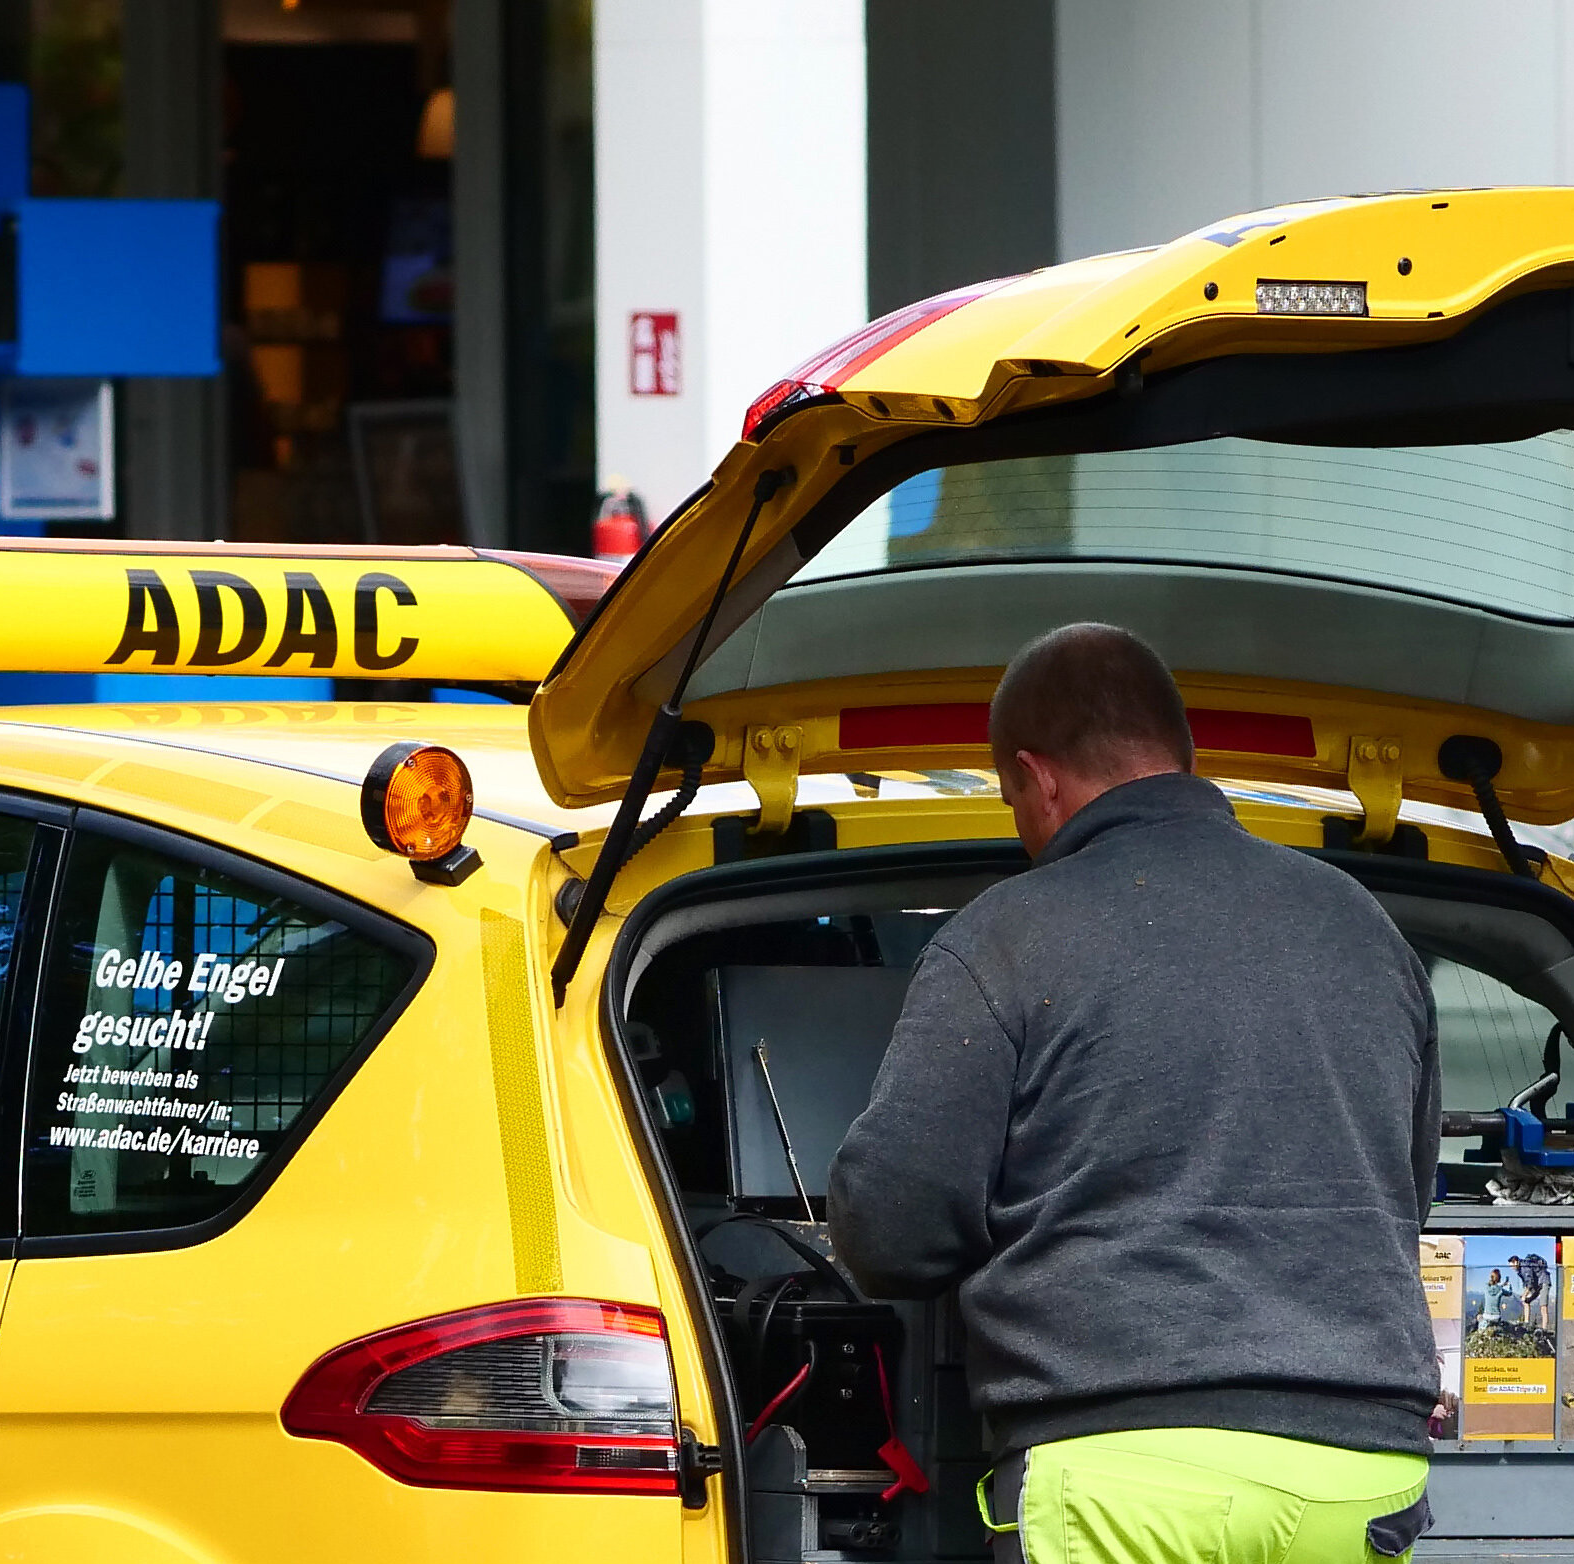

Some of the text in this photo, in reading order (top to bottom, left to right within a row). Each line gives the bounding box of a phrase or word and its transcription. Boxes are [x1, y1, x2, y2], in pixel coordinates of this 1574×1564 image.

[104, 568, 420, 670] ADAC
[96, 949, 285, 1003] Gelbe Engel
[72, 1009, 214, 1053] gesucht!
[63, 1064, 199, 1090] Jetzt bewerben als
[56, 1092, 233, 1122] Straßenwachtfahrer/in:
[49, 1125, 259, 1159] www.adac.de/karriere
[1434, 1251, 1452, 1260] ADAC
